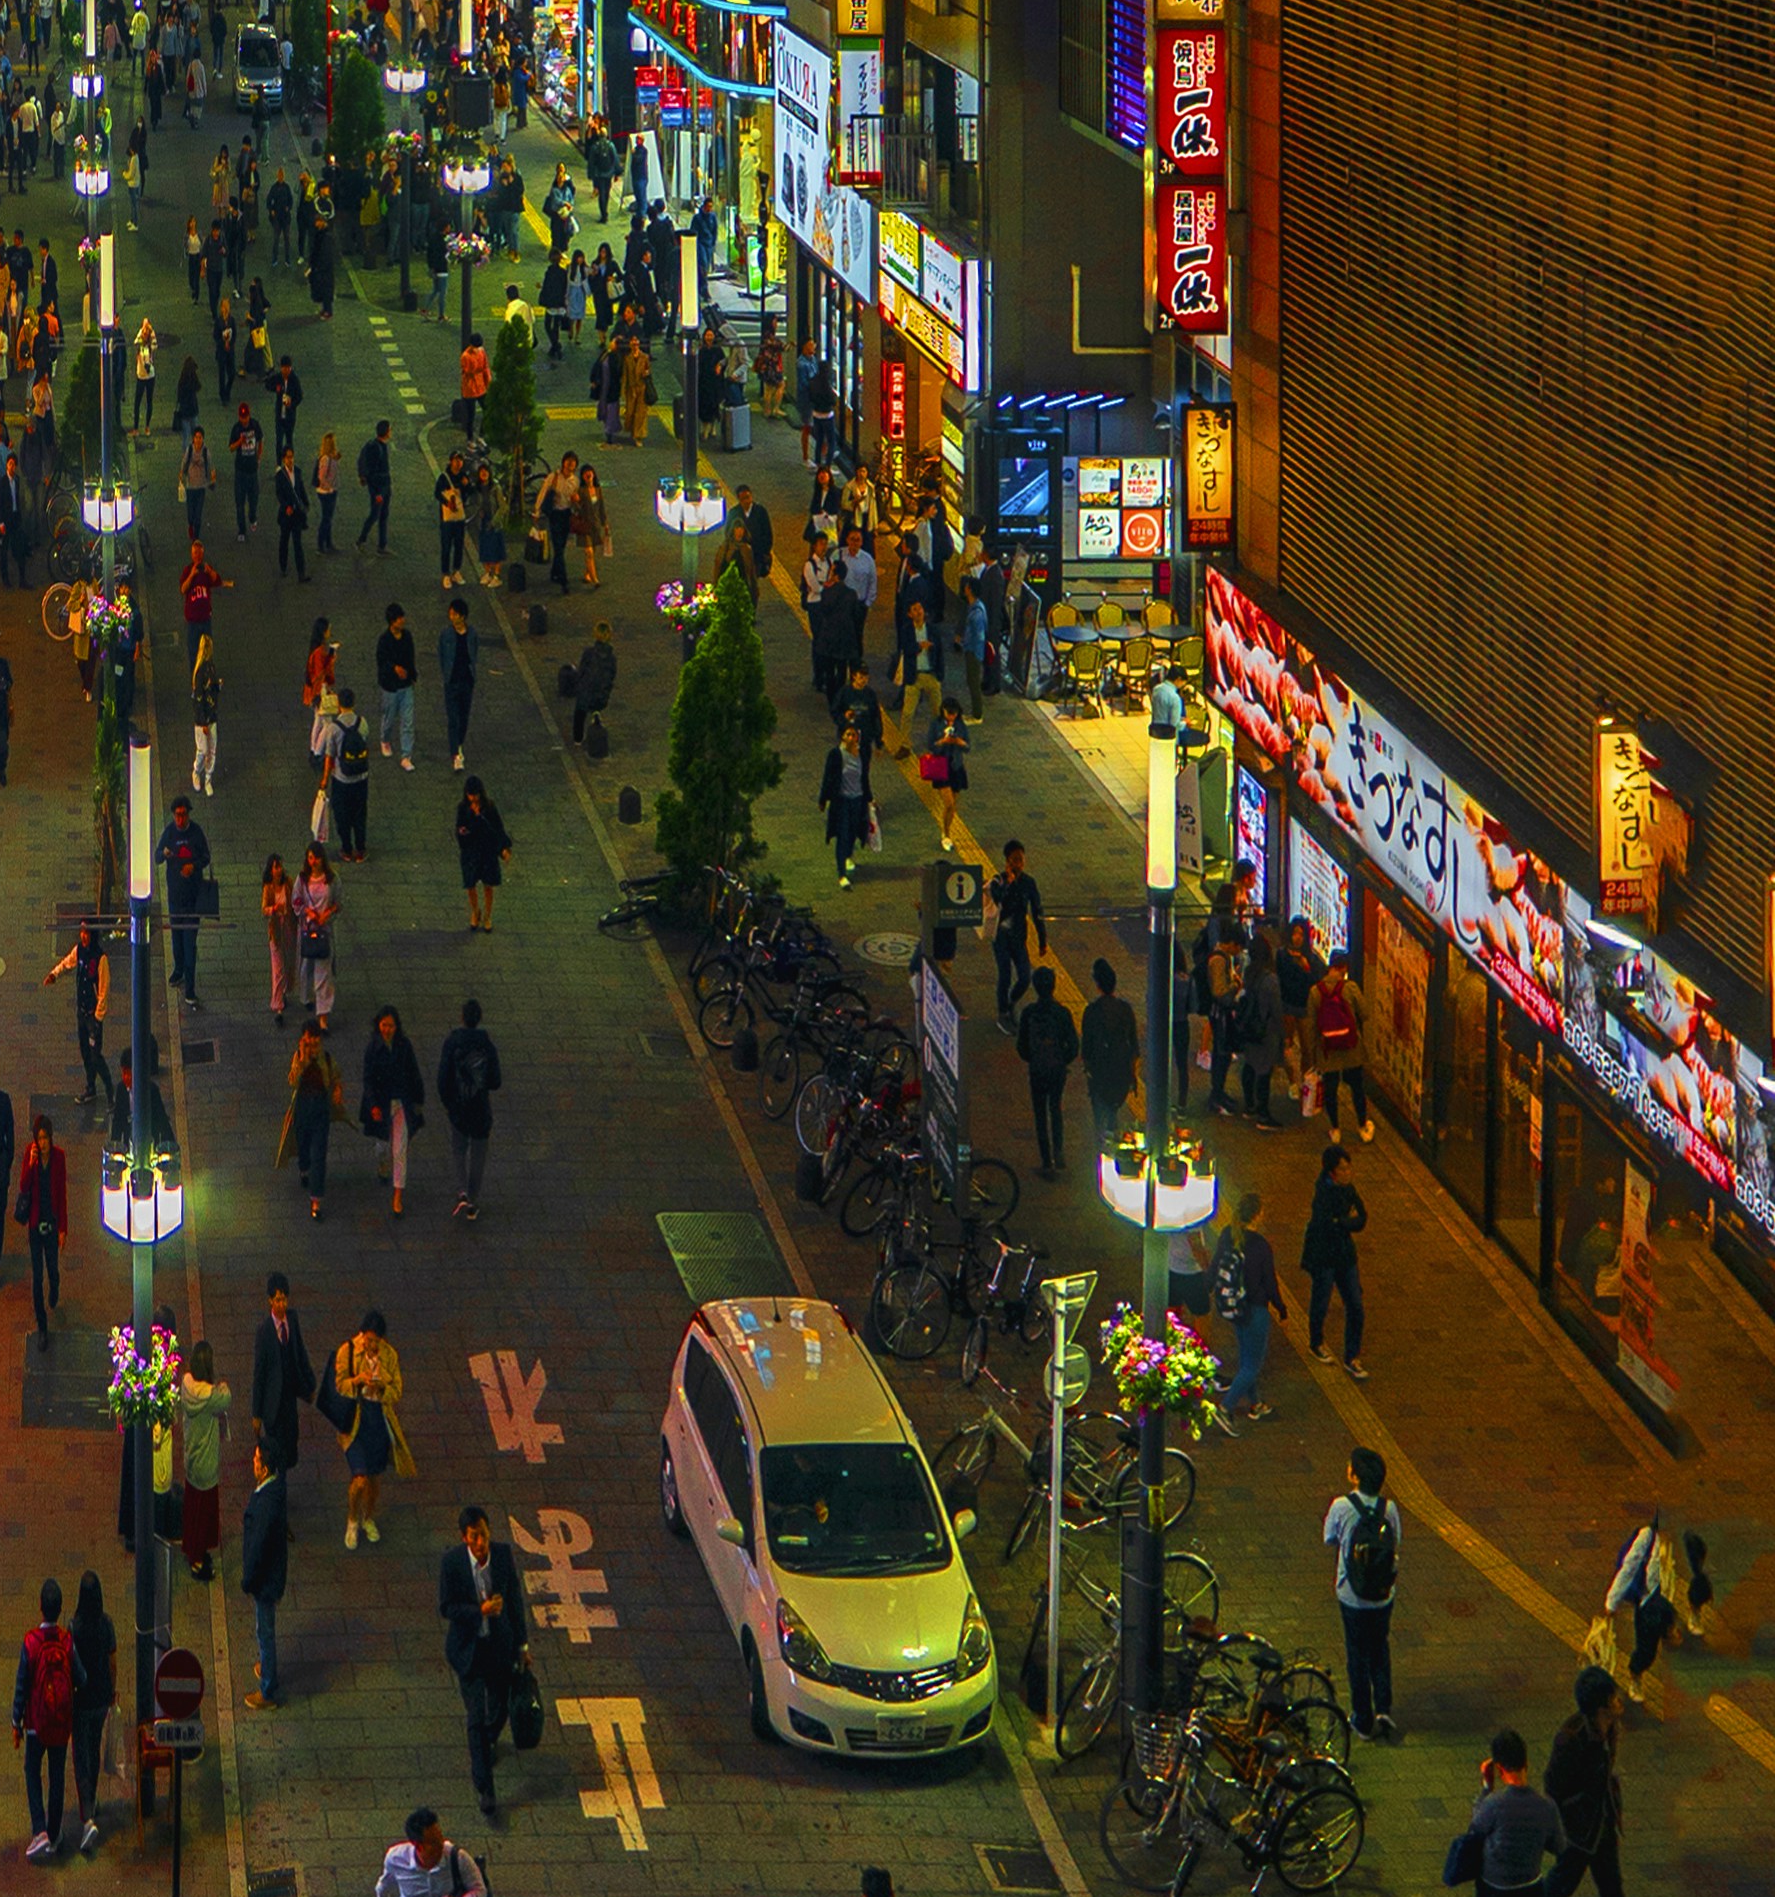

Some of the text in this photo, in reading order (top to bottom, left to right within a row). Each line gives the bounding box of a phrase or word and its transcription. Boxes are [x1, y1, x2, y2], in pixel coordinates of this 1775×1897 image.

[1173, 88, 1214, 158] 一休
[1173, 246, 1215, 314] 一休
[1195, 411, 1223, 514] きづなすし
[1347, 700, 1480, 947] きづなすし
